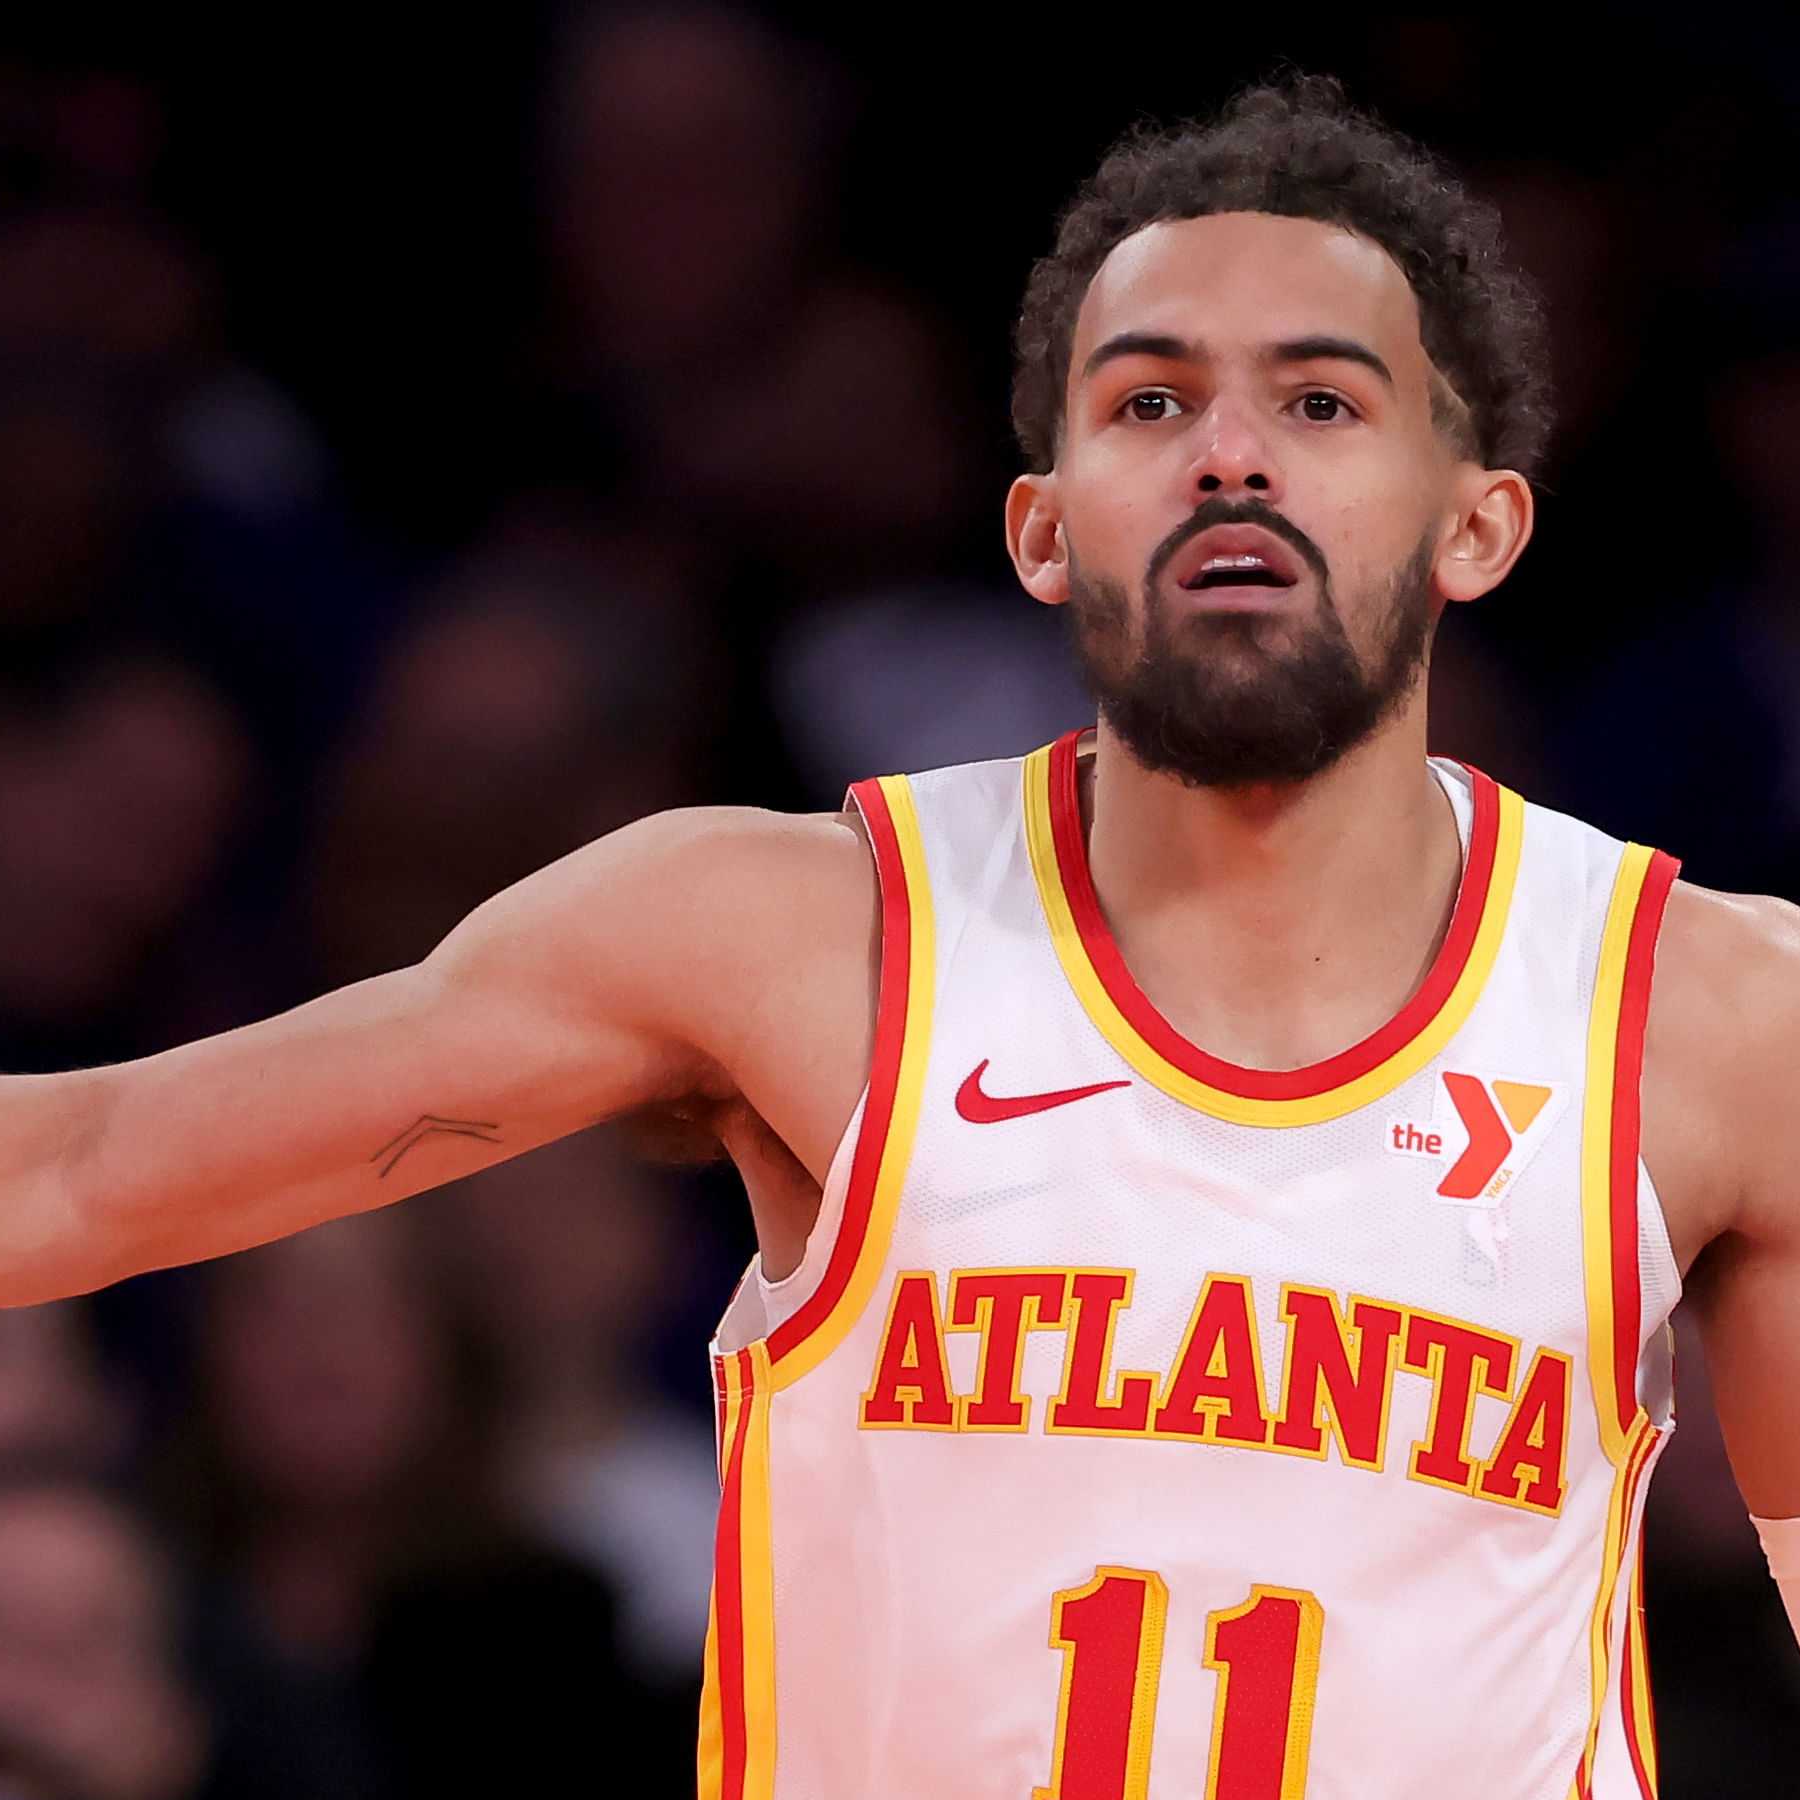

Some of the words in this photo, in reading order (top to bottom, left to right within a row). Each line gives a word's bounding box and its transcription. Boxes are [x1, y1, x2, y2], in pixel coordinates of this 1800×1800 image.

[1392, 1123, 1443, 1155] the
[1484, 1168, 1513, 1200] YMCA
[857, 1266, 1575, 1519] ATLANTA
